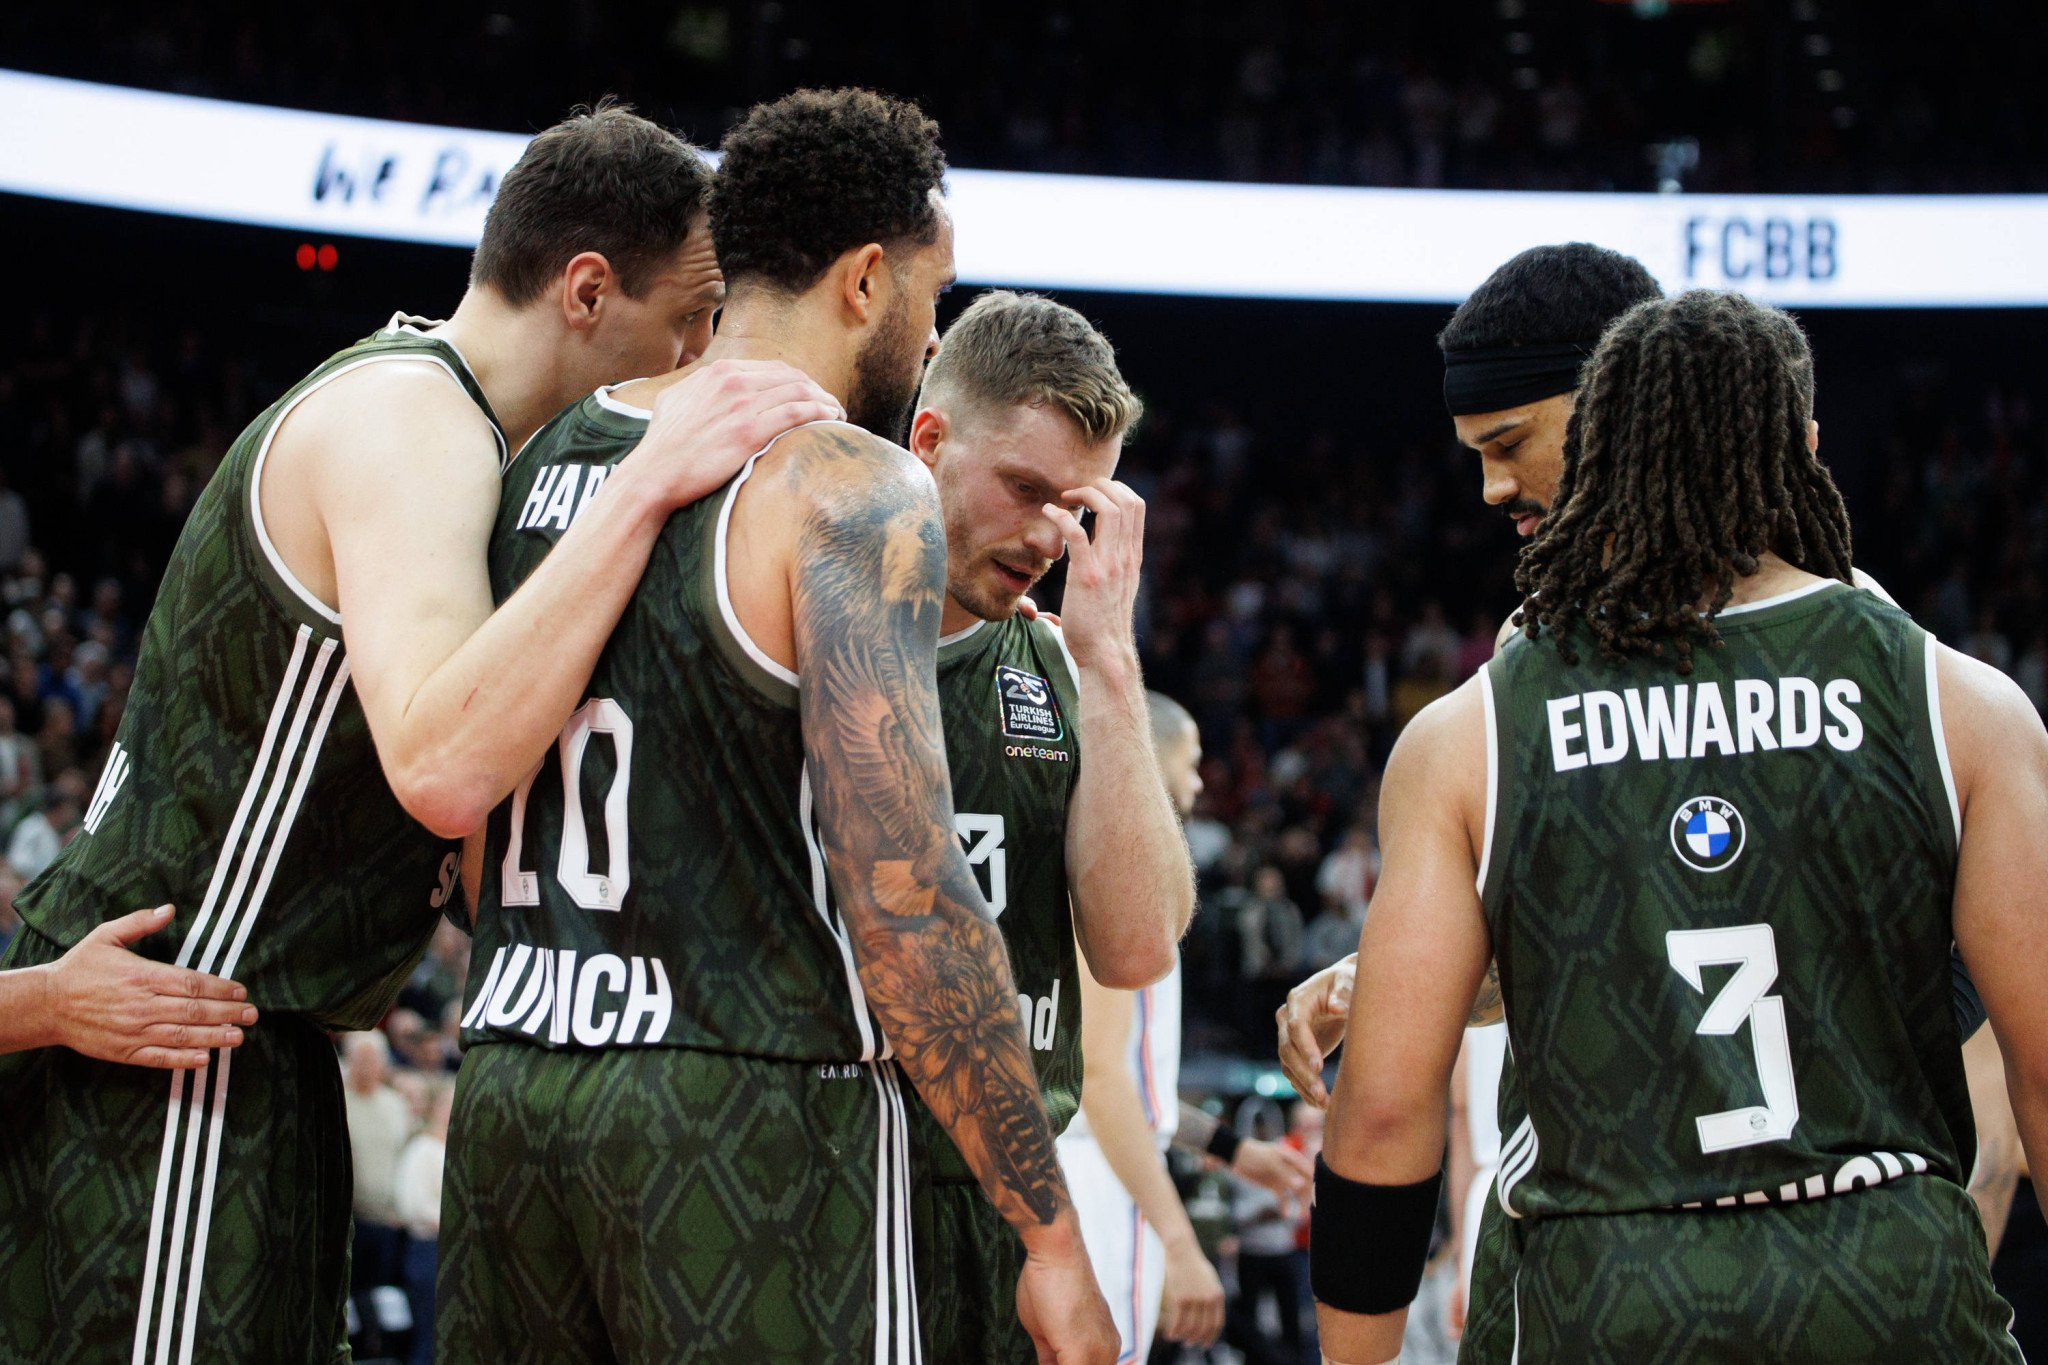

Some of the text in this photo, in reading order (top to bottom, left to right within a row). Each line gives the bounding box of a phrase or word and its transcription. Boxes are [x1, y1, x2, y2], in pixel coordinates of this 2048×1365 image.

[1684, 217, 1838, 280] FCBB
[1009, 704, 1053, 719] TURKISH
[1010, 712, 1055, 727] AIRLINES
[1010, 721, 1056, 734] EuroLeague
[1546, 676, 1864, 773] EDWARDS
[1005, 745, 1068, 762] oneteam
[1680, 800, 1734, 823] BMW
[1666, 922, 1799, 1154] 3
